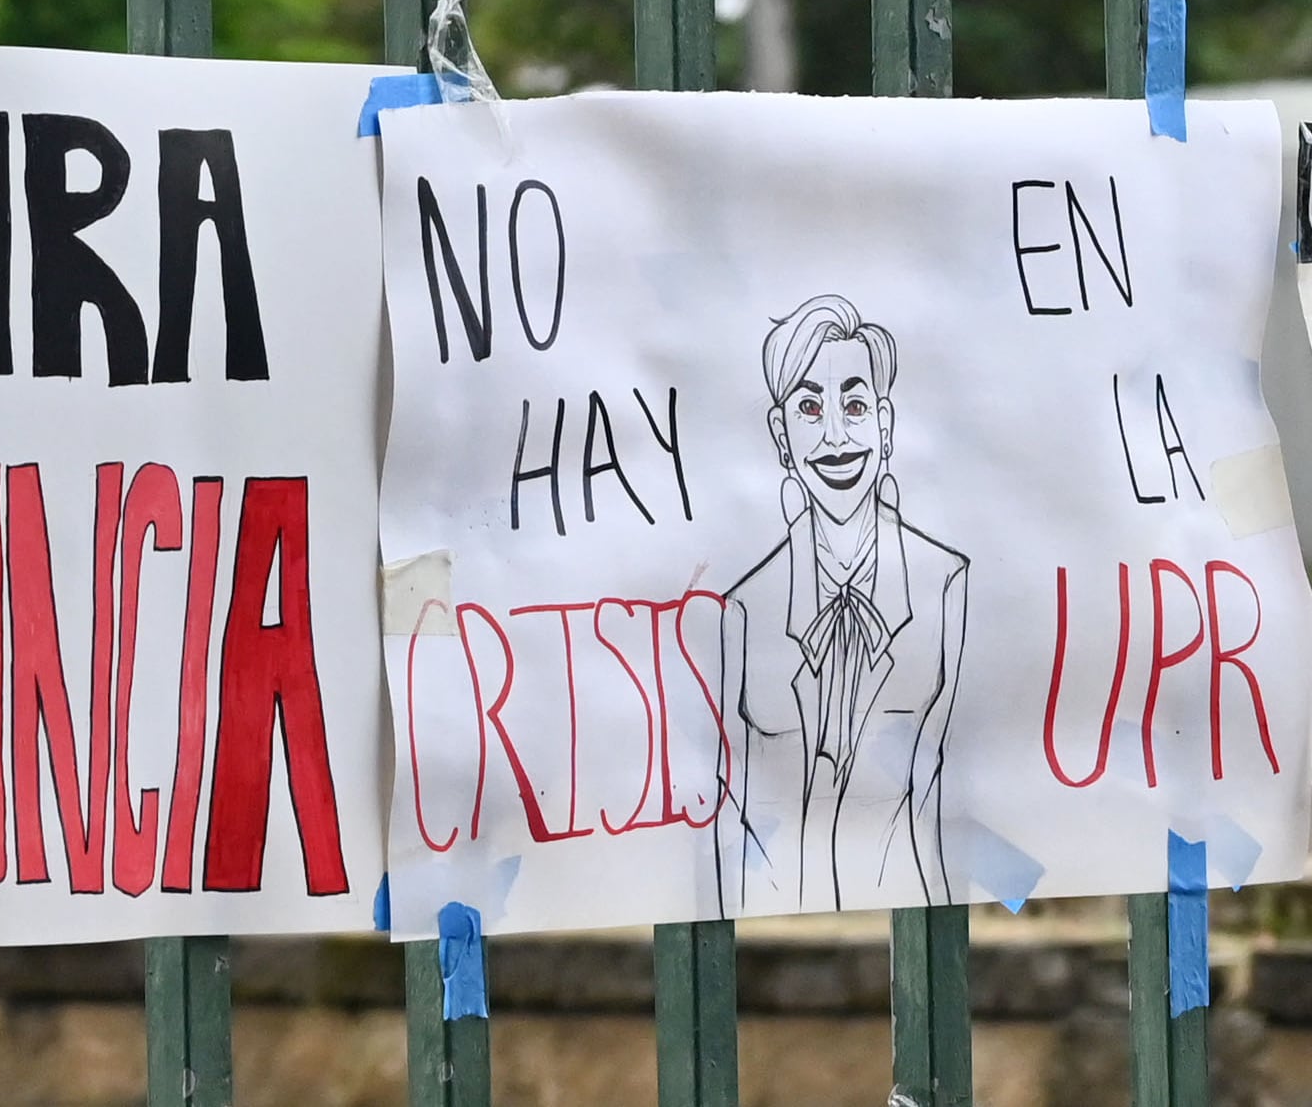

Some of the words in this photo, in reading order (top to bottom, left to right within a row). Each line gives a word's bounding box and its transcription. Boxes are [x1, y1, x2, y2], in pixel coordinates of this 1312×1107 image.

[418, 176, 565, 362] NO
[1012, 176, 1132, 314] EN
[511, 387, 692, 535] HAY
[1113, 374, 1206, 504] LA
[408, 588, 731, 852] CRISIS
[1043, 560, 1280, 789] UPR
